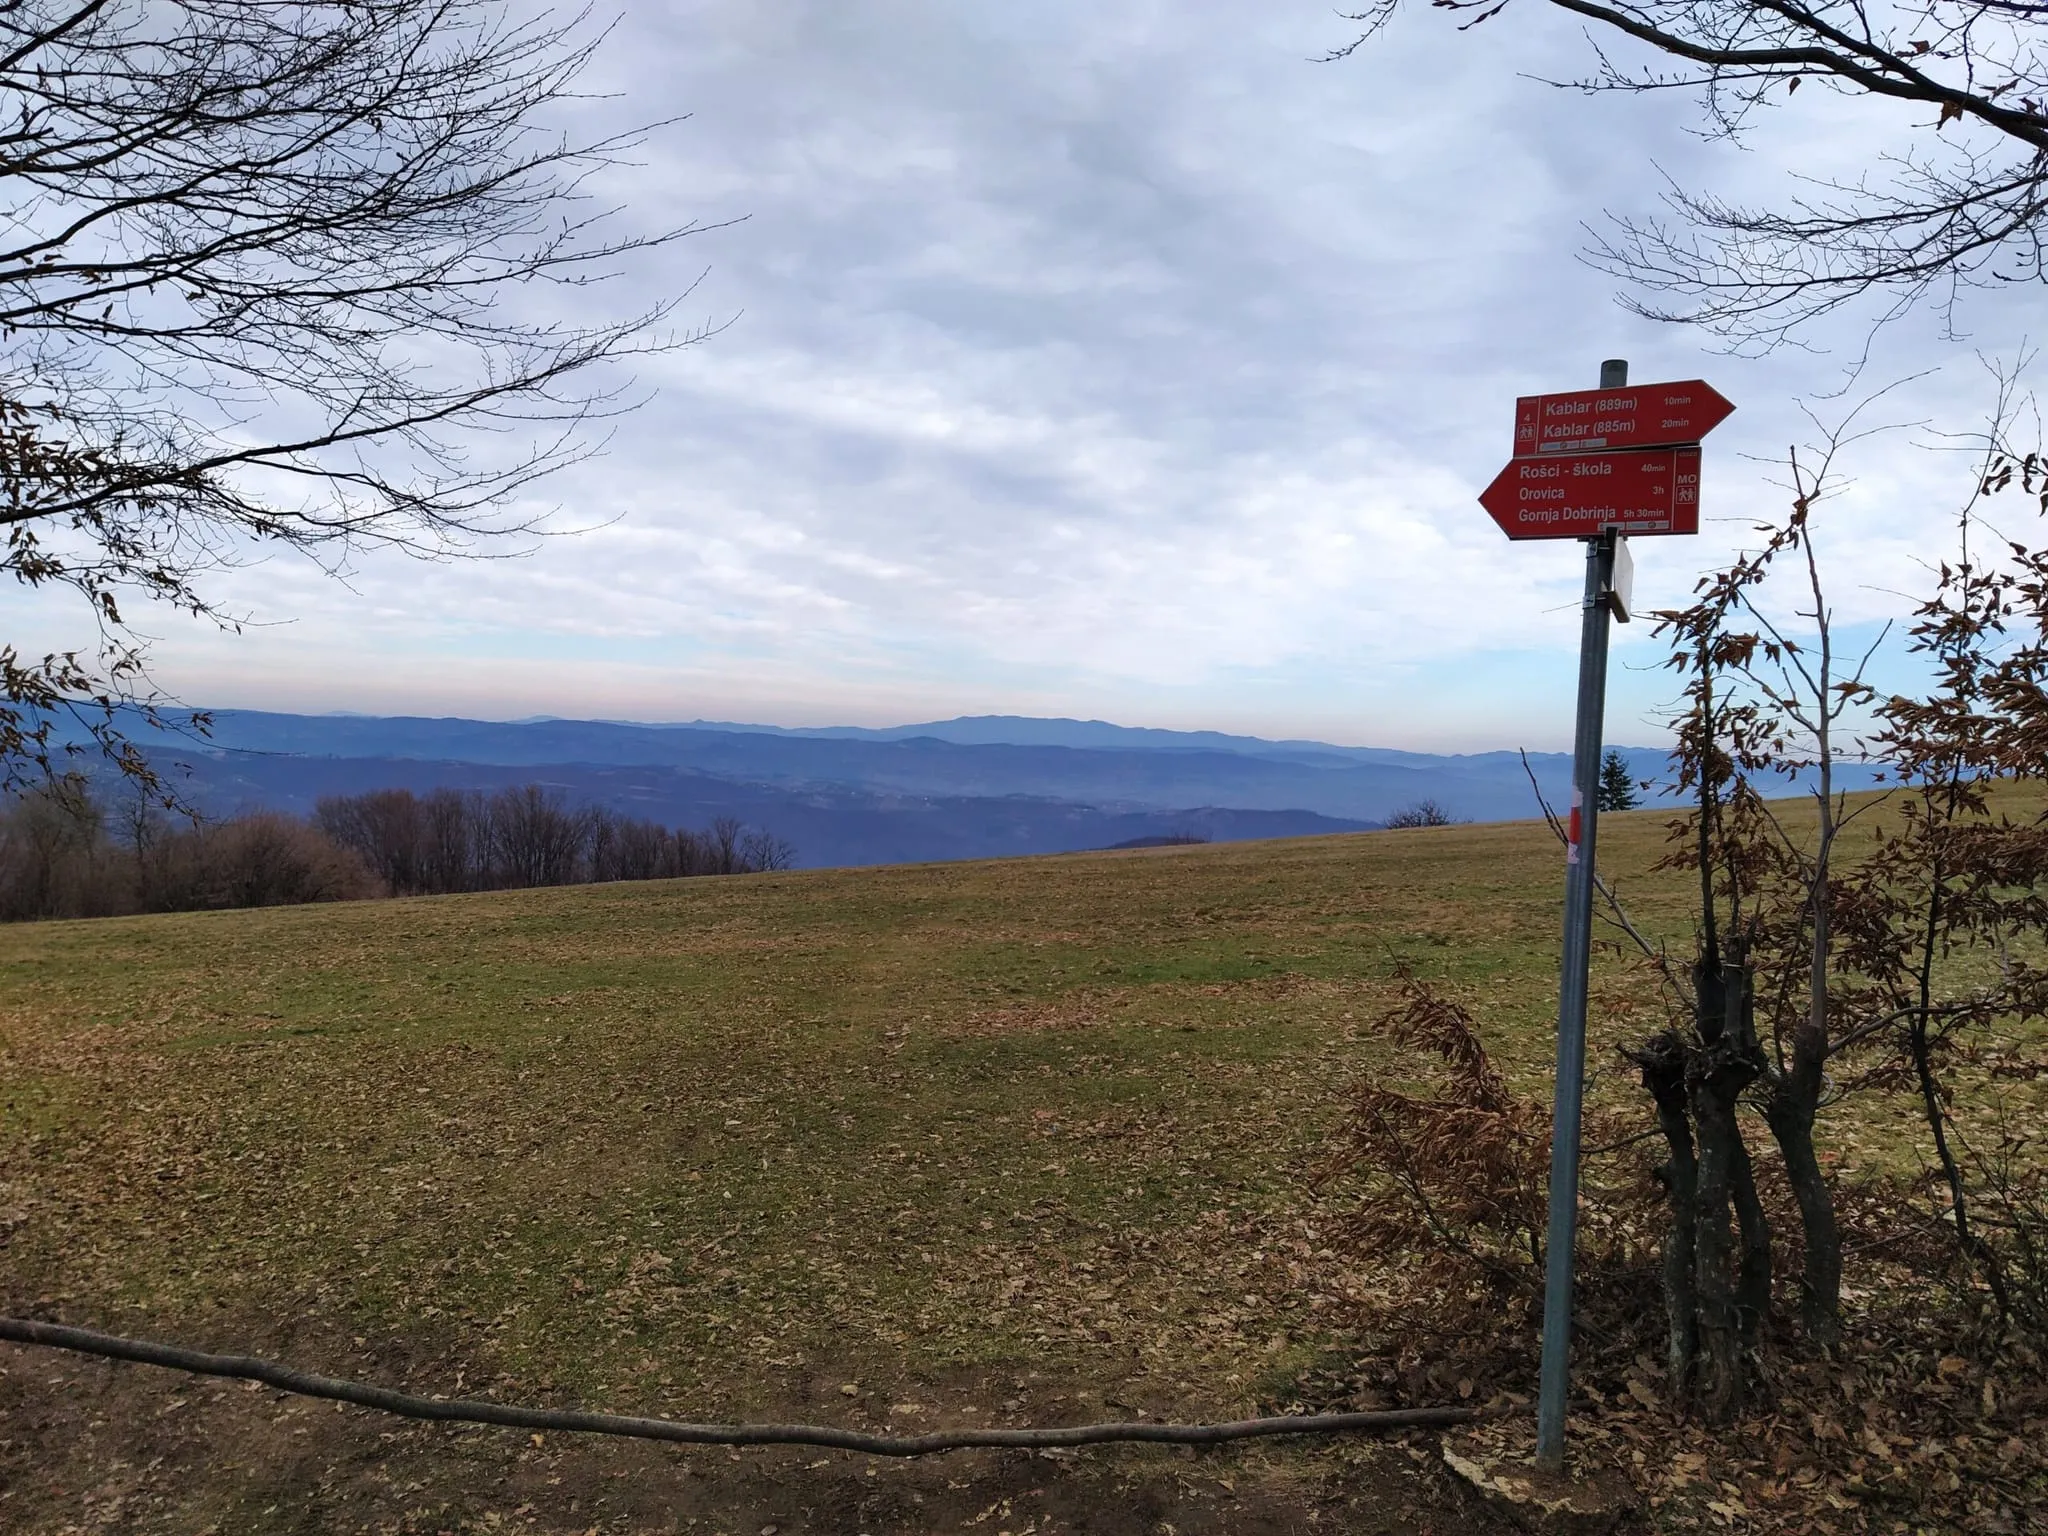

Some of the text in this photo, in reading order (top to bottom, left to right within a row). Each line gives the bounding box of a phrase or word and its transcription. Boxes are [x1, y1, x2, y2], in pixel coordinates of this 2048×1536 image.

[1664, 396, 1691, 405] 10min
[1546, 396, 1637, 416] Kablar (889m)
[1524, 413, 1530, 422] 4
[1662, 418, 1689, 428] 20min
[1544, 419, 1635, 438] Kablar (885m)
[1573, 461, 1612, 476] škola
[1641, 463, 1665, 472] 40min
[1677, 474, 1697, 484] MO
[1519, 486, 1565, 500] Orovica
[1652, 486, 1664, 495] 3h
[1519, 505, 1616, 524] Gornja Dobrinja
[1623, 508, 1664, 518] 5h 30min
